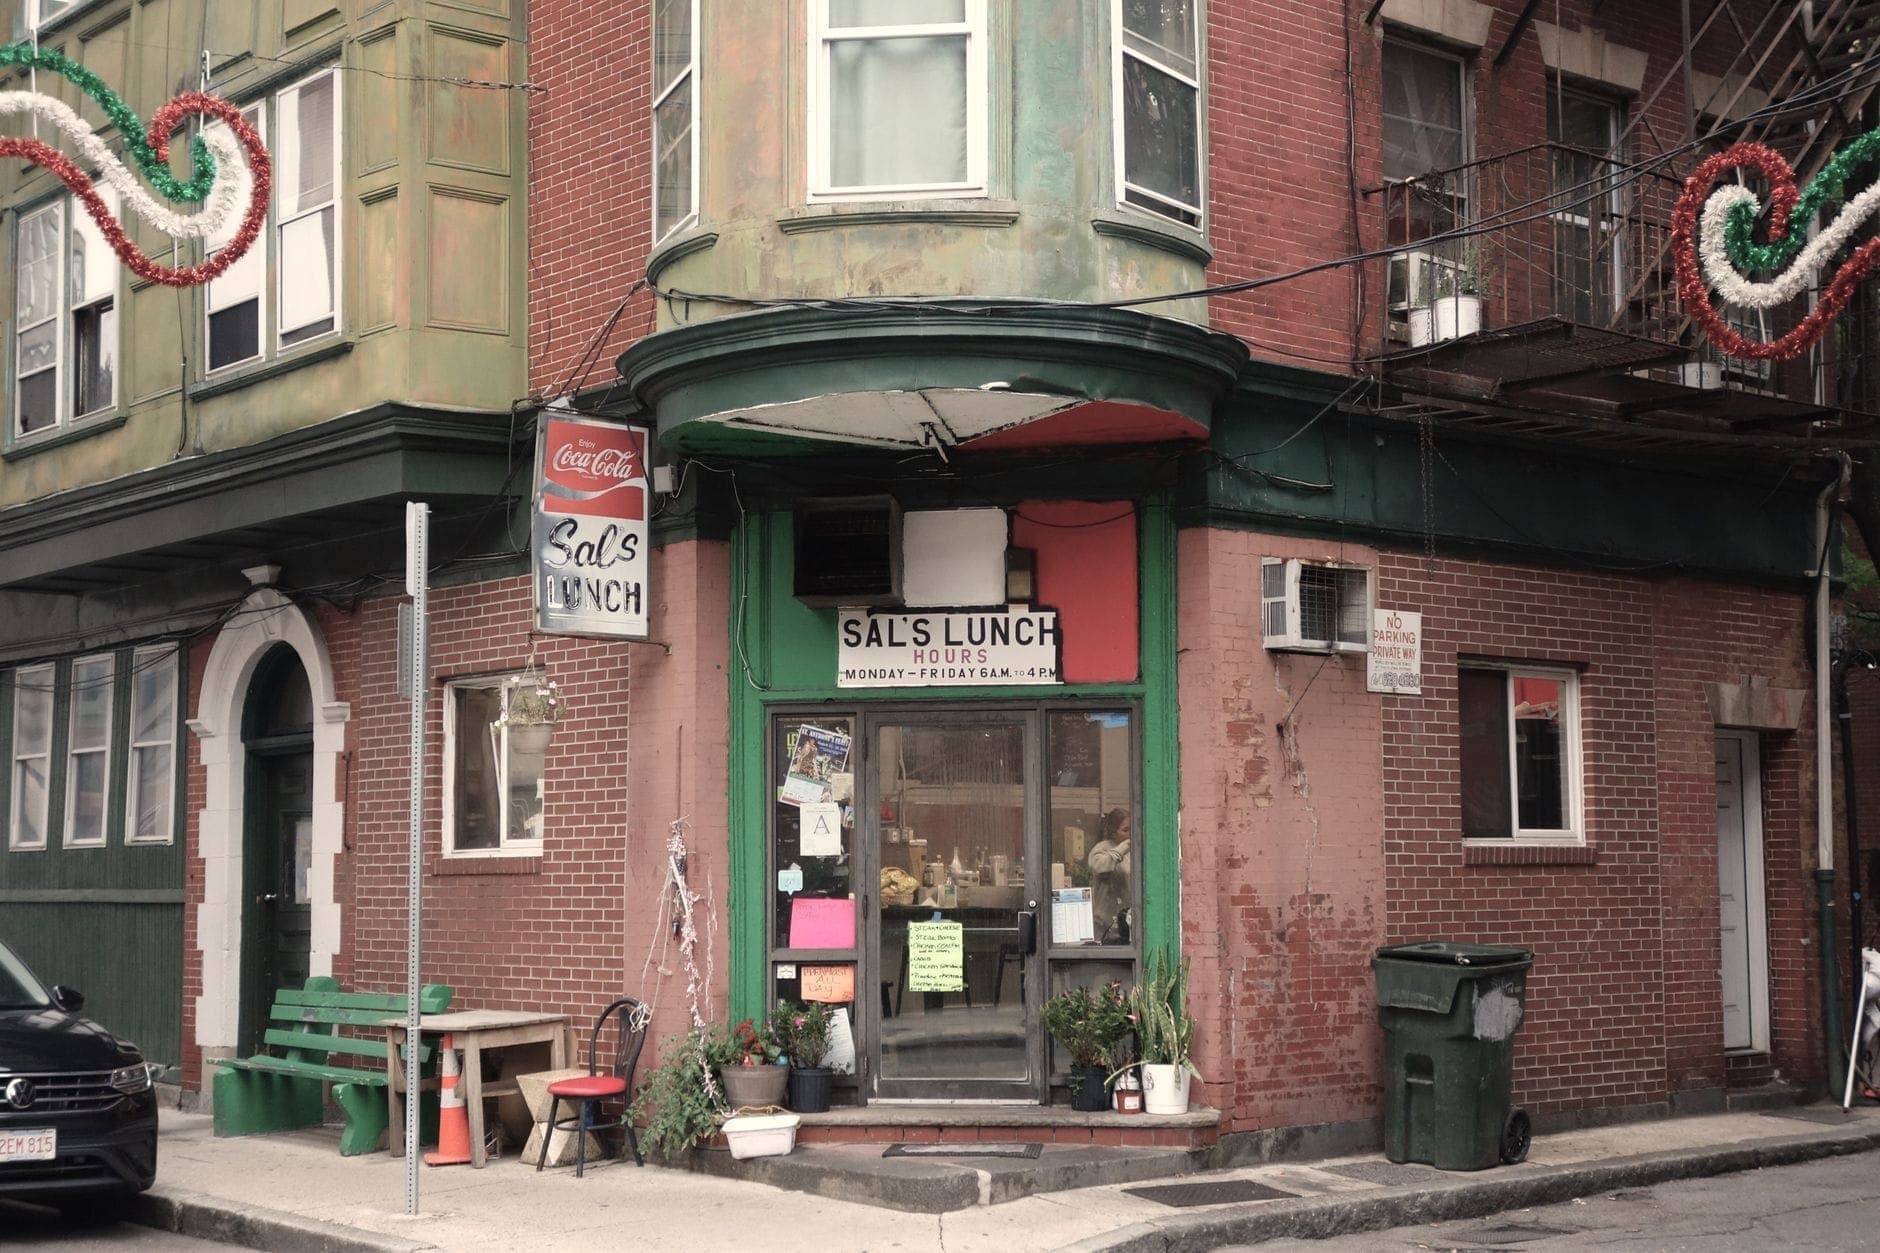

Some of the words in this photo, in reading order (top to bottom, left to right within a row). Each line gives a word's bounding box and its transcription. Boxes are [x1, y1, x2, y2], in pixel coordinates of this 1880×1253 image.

[578, 438, 596, 449] Enjoy
[552, 443, 638, 479] Coca-Cola
[546, 574, 641, 615] LUNCH
[1386, 617, 1402, 630] NO
[843, 617, 931, 648] SAL'S
[944, 616, 1057, 646] LUNCH
[1374, 629, 1416, 645] PARKING
[913, 649, 988, 664] HOURS
[1372, 645, 1401, 659] PRIVATE
[1402, 648, 1417, 660] WAY
[845, 668, 904, 680] MONDAY
[920, 667, 976, 679] FRIDAY
[813, 815, 830, 834] A
[28, 1136, 53, 1154] 815
